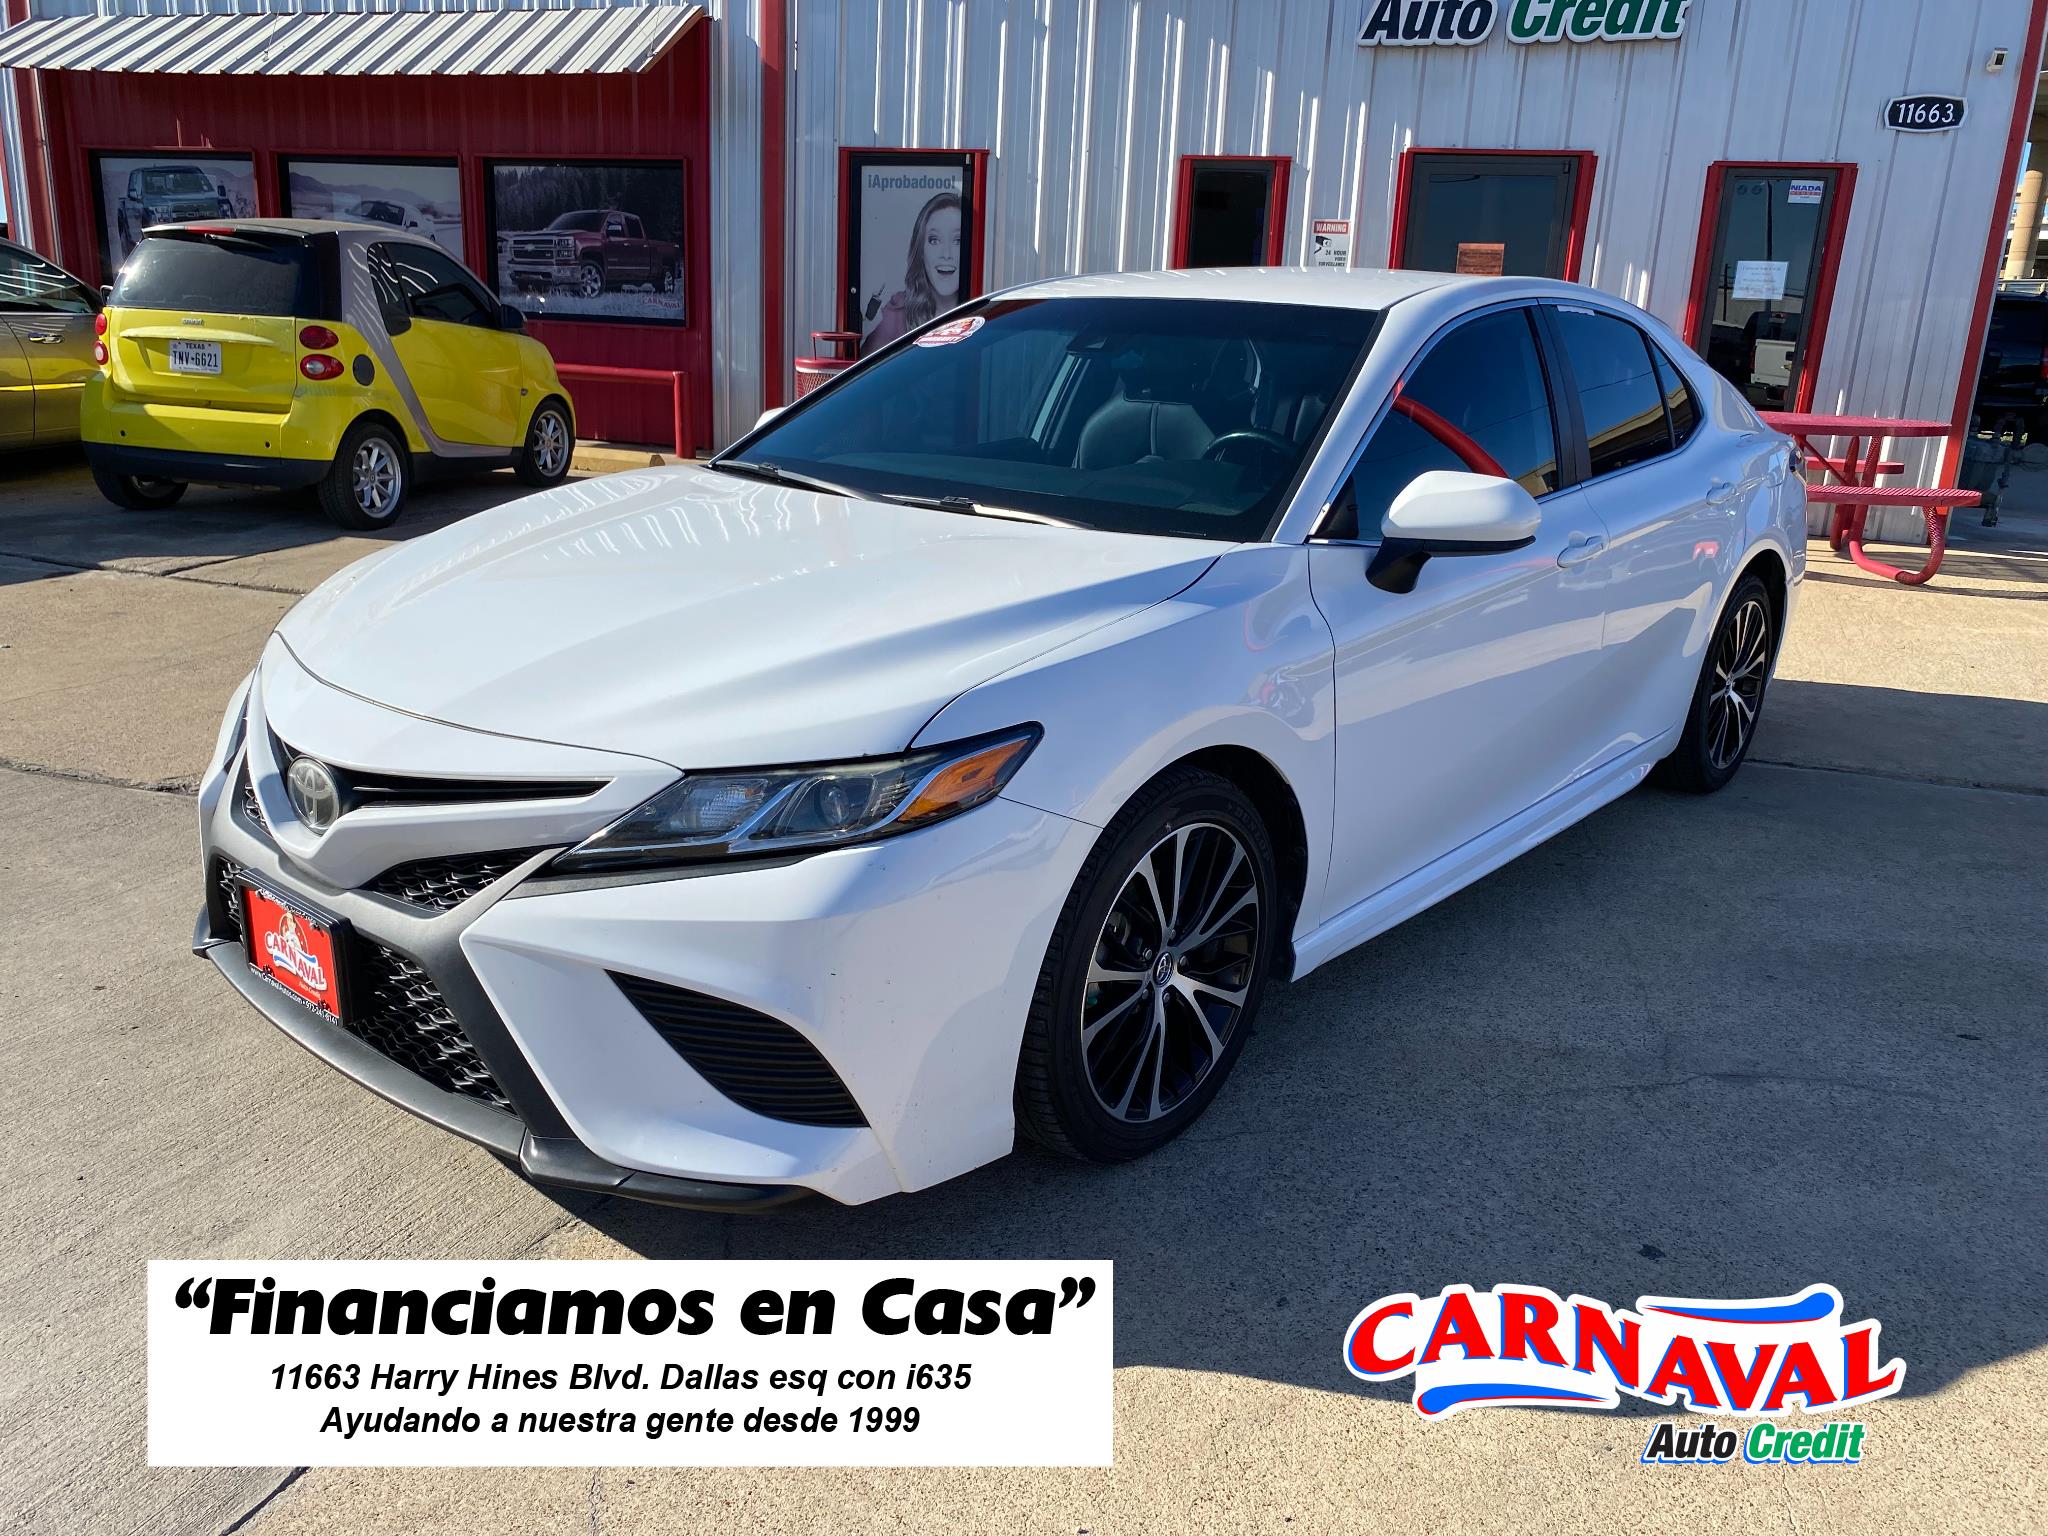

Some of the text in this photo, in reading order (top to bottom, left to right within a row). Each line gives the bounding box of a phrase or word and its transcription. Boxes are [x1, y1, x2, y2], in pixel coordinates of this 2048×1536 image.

[1361, 0, 1684, 40] Auto Credit
[1898, 103, 1955, 123] 11663
[1790, 184, 1822, 192] NIADA
[1316, 223, 1347, 232] WARNING
[185, 342, 206, 350] TEXAS
[265, 932, 326, 986] CARNAVAL
